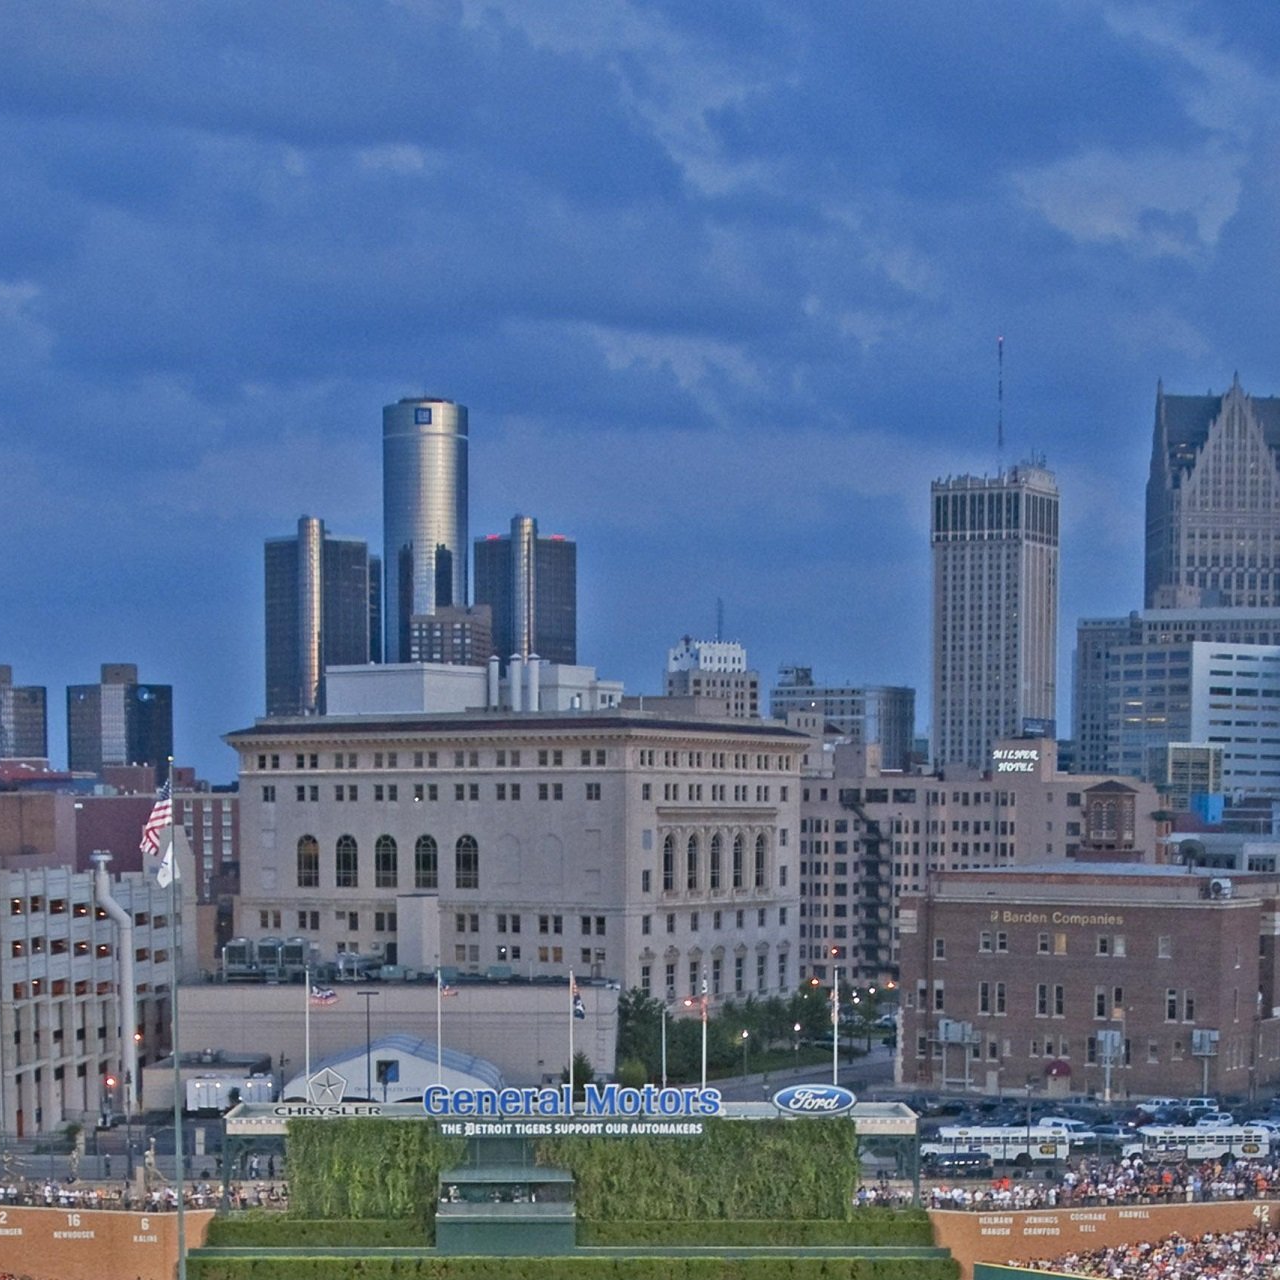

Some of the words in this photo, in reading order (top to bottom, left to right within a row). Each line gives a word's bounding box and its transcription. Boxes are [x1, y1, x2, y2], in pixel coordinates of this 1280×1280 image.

[992, 749, 1040, 761] MILNER
[998, 761, 1034, 772] HOTEL
[1052, 912, 1124, 926] Companies
[422, 1083, 574, 1117] General
[584, 1083, 722, 1116] Motors
[788, 1088, 839, 1111] Ford
[274, 1106, 383, 1116] CHRYSLER
[441, 1123, 461, 1135] THE
[515, 1123, 552, 1135] TIGERS
[555, 1123, 603, 1134] SUPPORT
[605, 1123, 628, 1134] OUR
[630, 1123, 703, 1134] AUTOMAKERS
[66, 1214, 81, 1227] 16
[141, 1217, 149, 1231] 6
